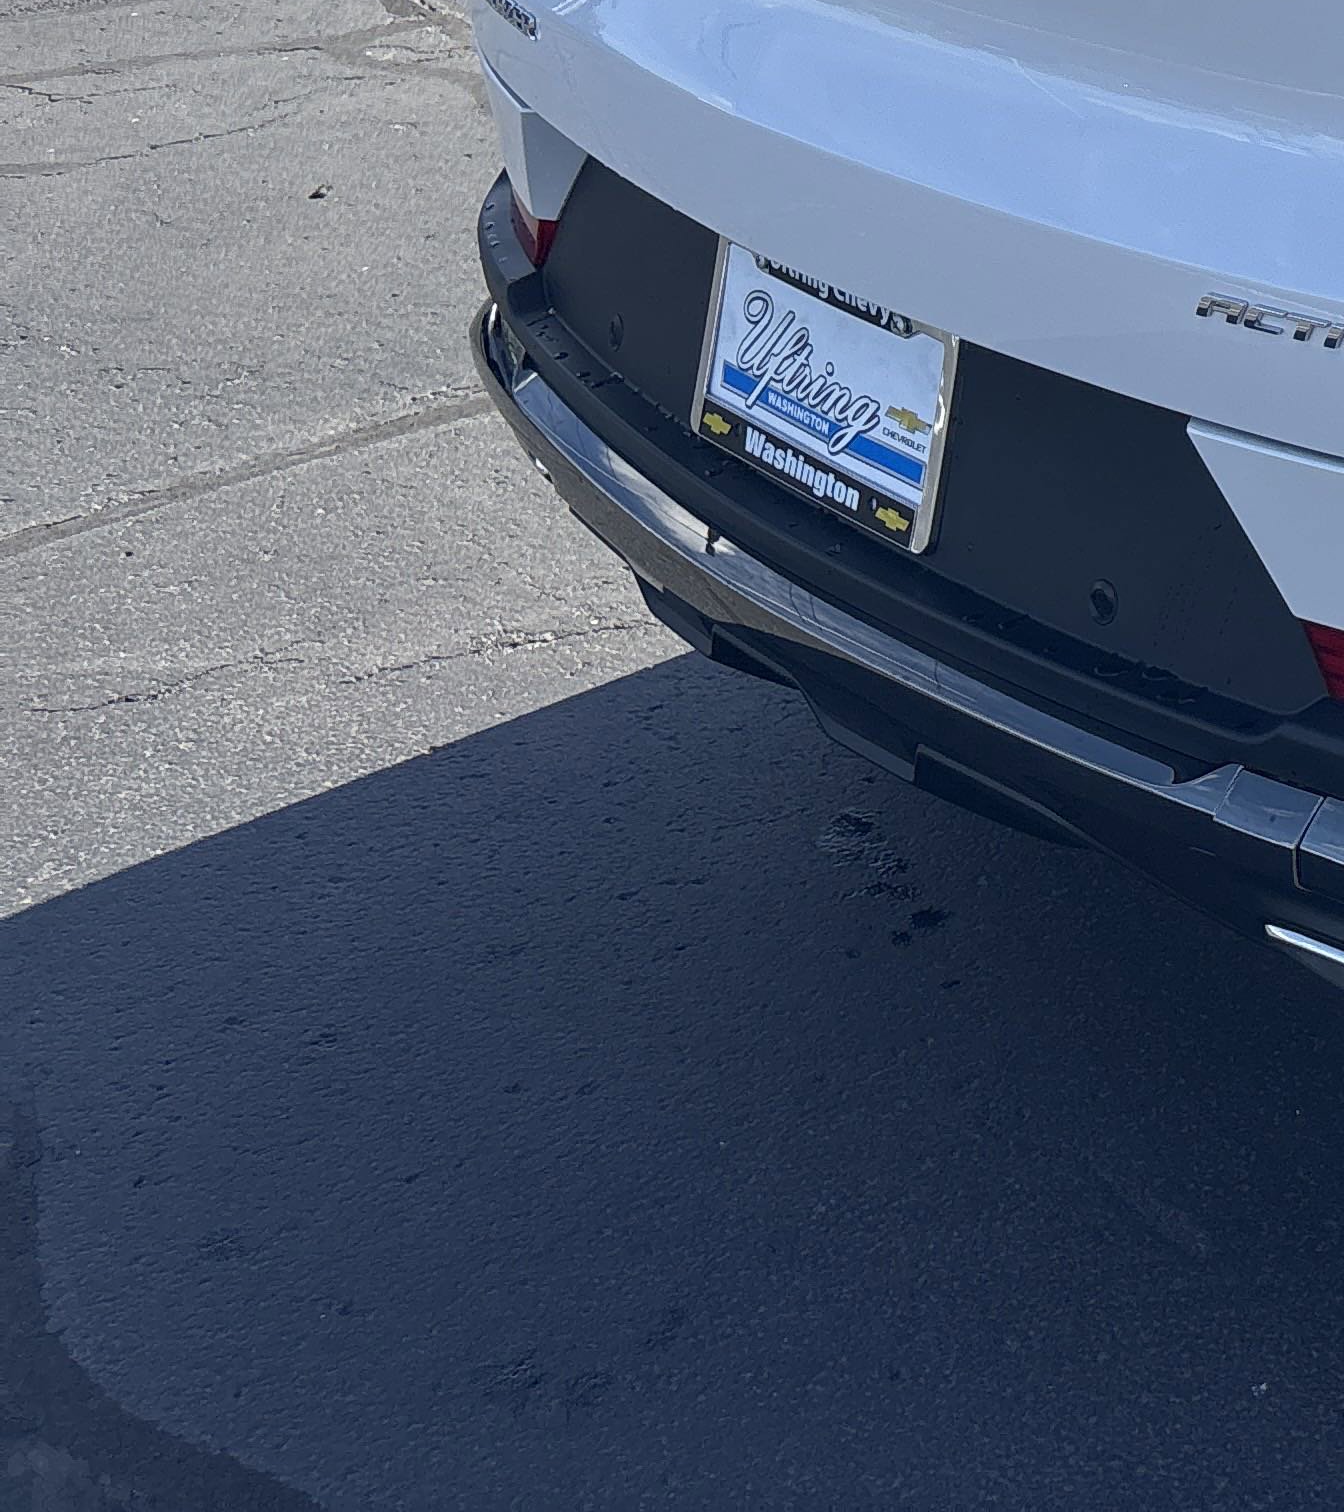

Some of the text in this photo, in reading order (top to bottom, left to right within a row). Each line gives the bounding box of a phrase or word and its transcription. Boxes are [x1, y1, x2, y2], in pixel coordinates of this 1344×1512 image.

[736, 289, 881, 457] Uftring
[768, 390, 830, 437] WASHINGTON
[882, 426, 927, 454] CHEVROLET
[744, 426, 860, 512] Washington
